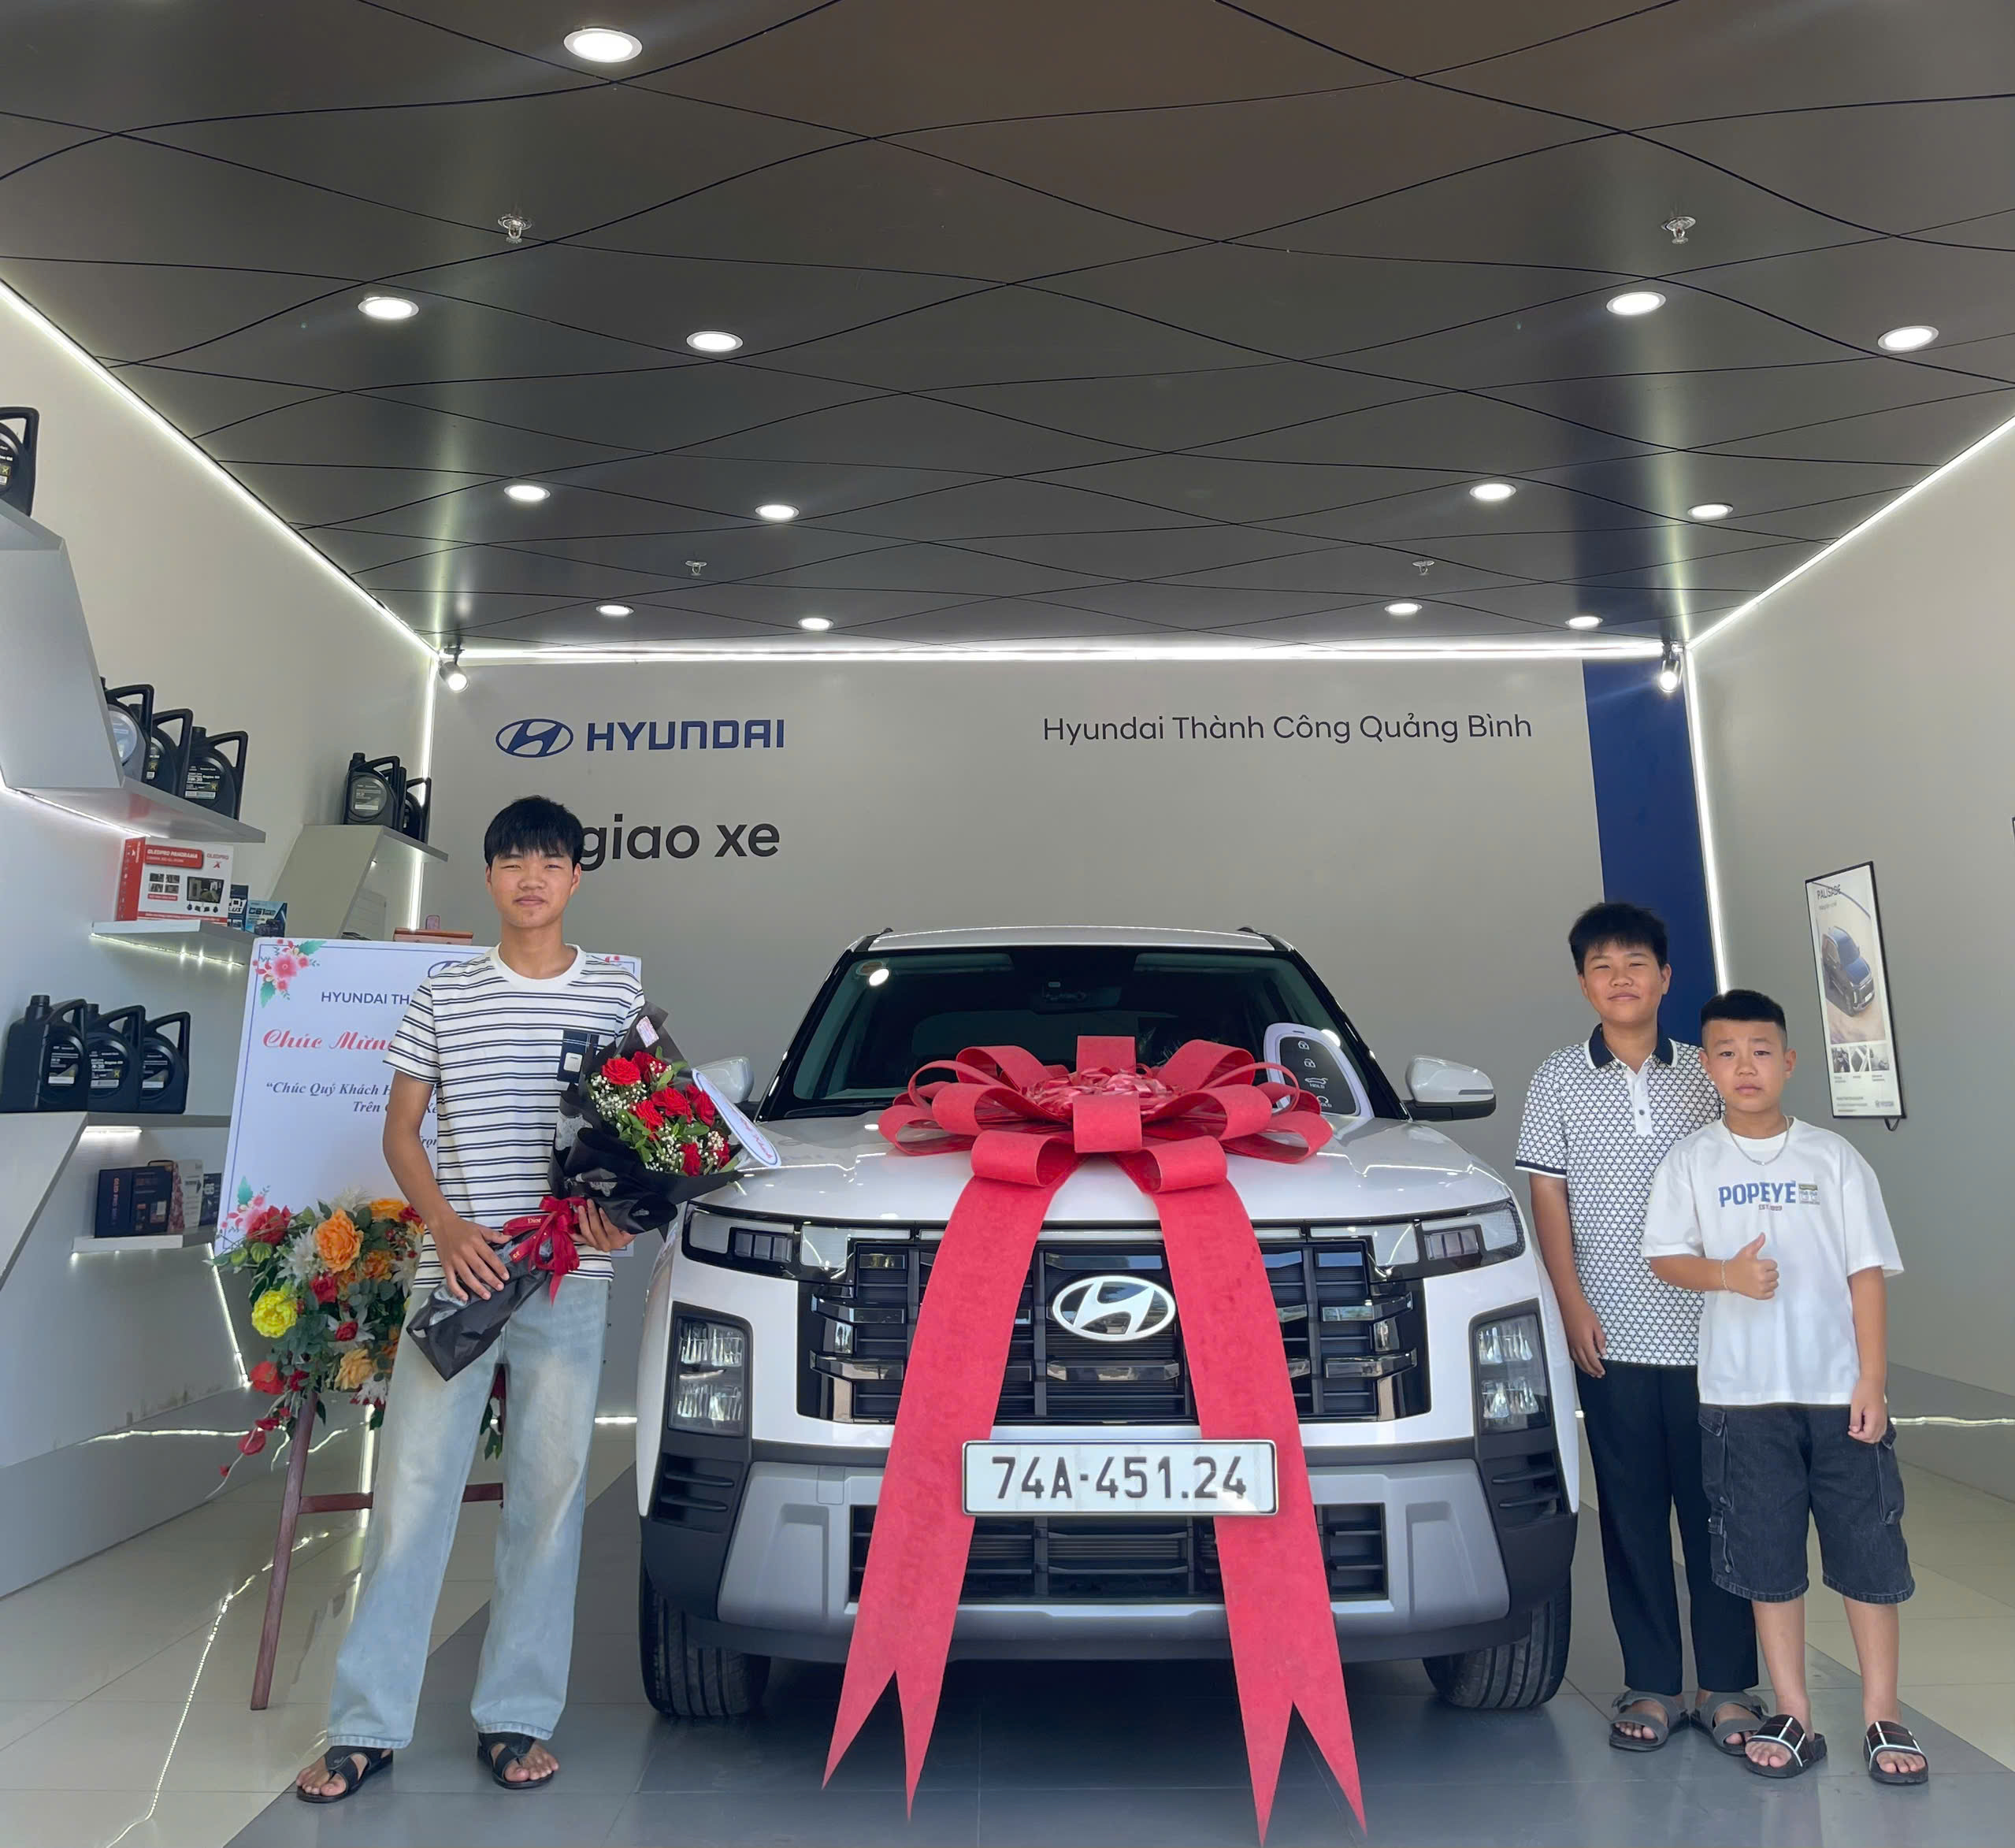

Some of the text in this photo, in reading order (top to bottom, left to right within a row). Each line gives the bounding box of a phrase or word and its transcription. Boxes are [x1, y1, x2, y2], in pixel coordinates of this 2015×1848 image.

[587, 719, 785, 751] HYUNDAI
[1044, 712, 1532, 746] Hyundai Thành Công Quảng Bình
[581, 813, 781, 871] giao xe
[321, 992, 410, 1005] HYUNDAI TH
[262, 1029, 322, 1048] Chúc
[310, 1083, 336, 1097] Quý
[339, 1084, 379, 1096] Khách
[353, 1101, 380, 1113] Trên
[991, 1456, 1247, 1499] 74A-451.24
